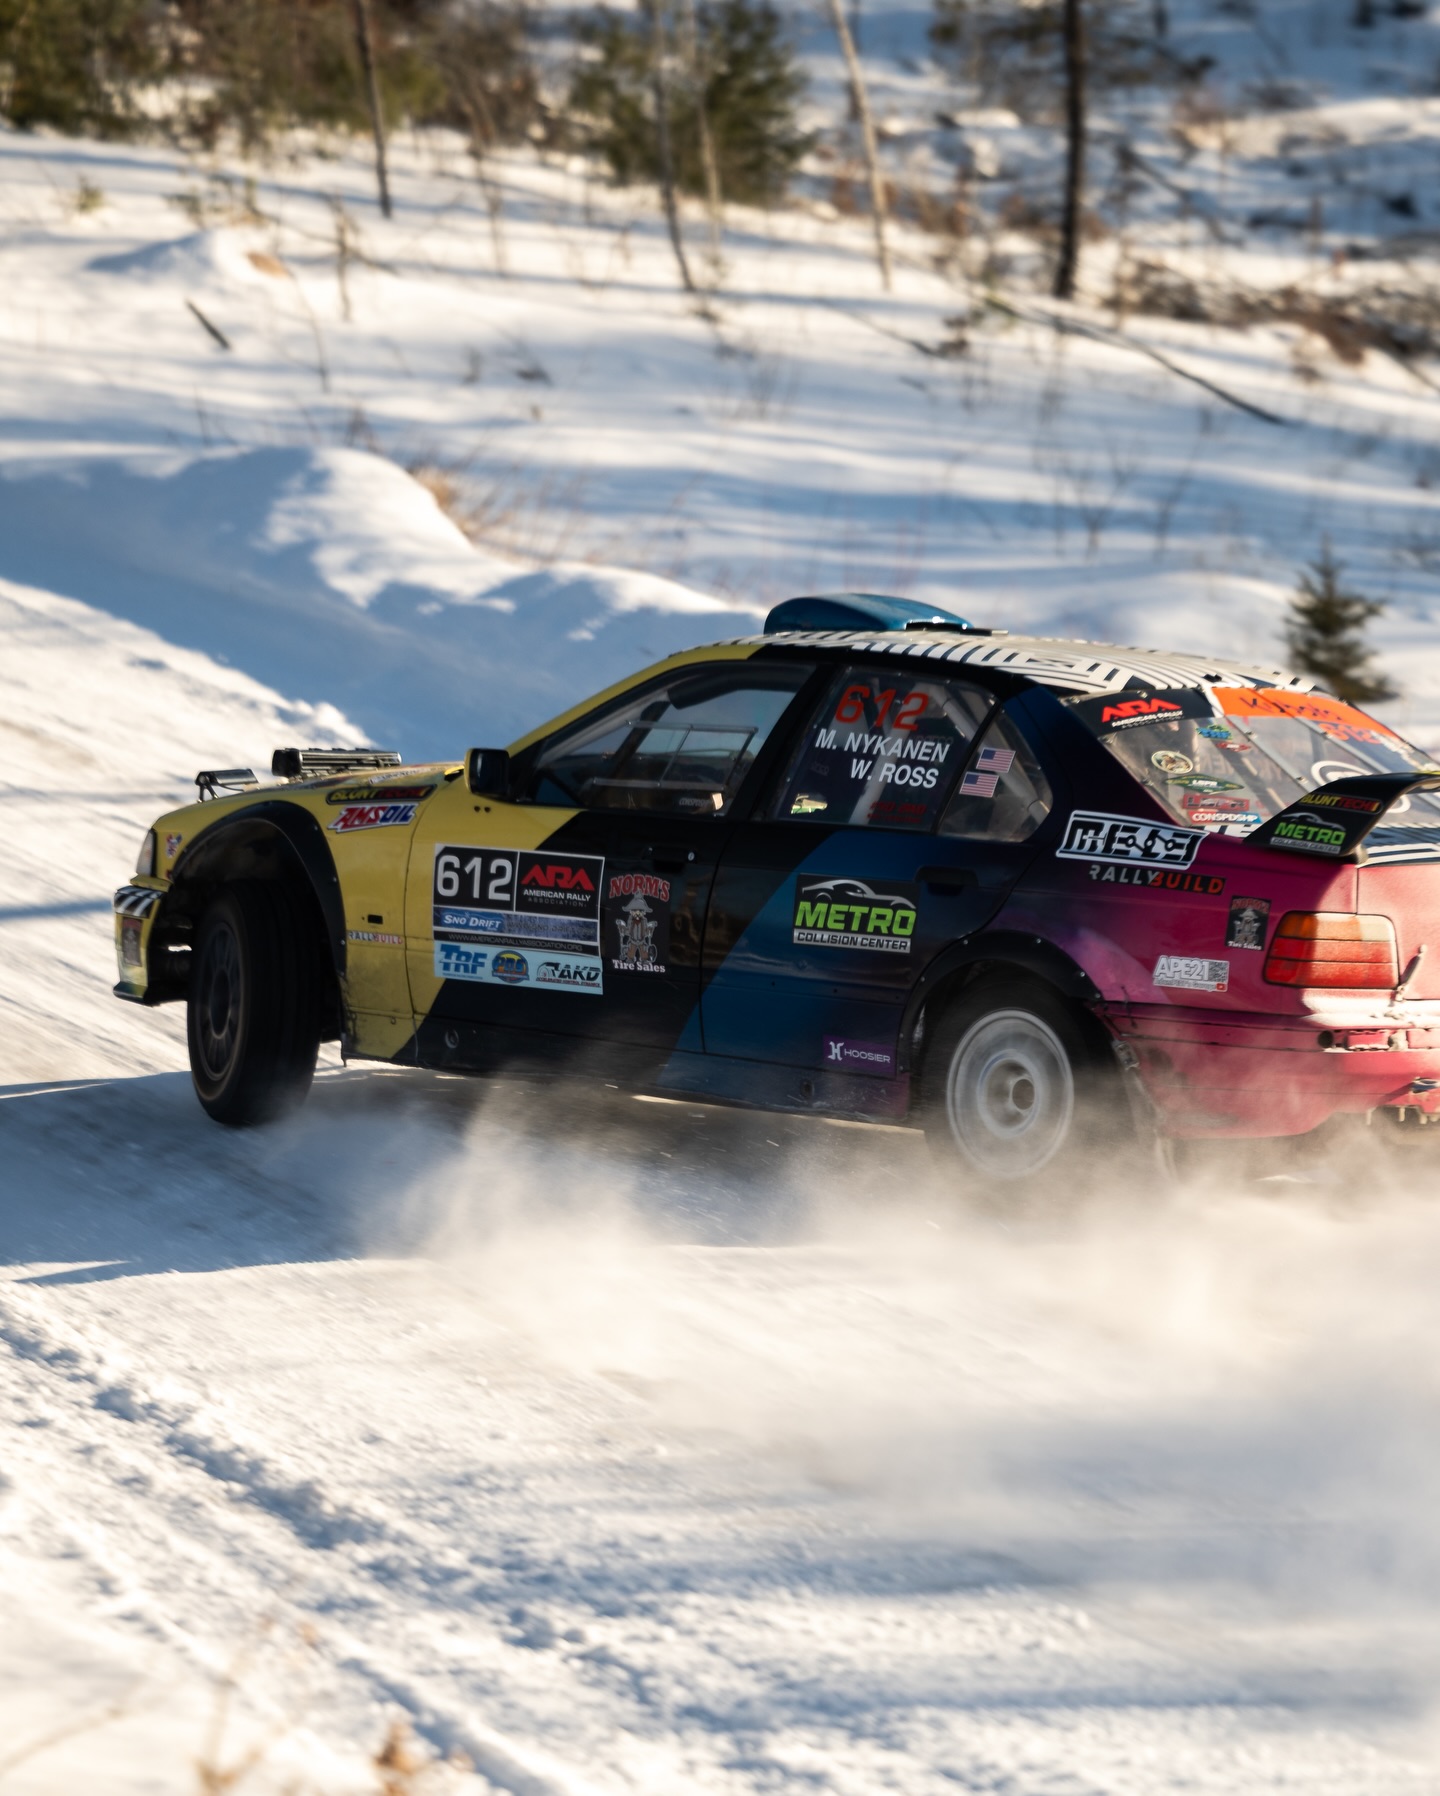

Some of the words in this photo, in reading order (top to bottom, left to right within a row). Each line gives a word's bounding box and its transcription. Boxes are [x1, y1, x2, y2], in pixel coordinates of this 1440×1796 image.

[834, 684, 929, 731] 612
[1102, 698, 1182, 723] ARA
[1112, 714, 1157, 727] AMERICAN
[1157, 710, 1184, 719] RALLY
[815, 728, 836, 750] M.
[844, 732, 950, 763] NYKANEN
[851, 758, 872, 781] W.
[879, 763, 939, 789] ROSS
[333, 805, 414, 829] AMSOIL
[1274, 822, 1346, 846] METRO
[437, 855, 512, 901] 612
[521, 864, 595, 891] ARA
[609, 874, 670, 902] NORM'S
[523, 889, 564, 900] AMERICAN
[566, 893, 591, 902] RALLY
[528, 897, 585, 907] ASSOCIATION
[444, 915, 467, 926] SNO
[469, 917, 501, 929] DRIFT
[795, 901, 917, 936] METRO
[450, 934, 583, 951] WWW.AMERICANRALLYASSOCIATION.ORG
[797, 932, 858, 947] COLLISION
[860, 938, 908, 951] CENTER
[440, 943, 488, 975] TRF
[612, 959, 635, 971] Tire
[636, 961, 666, 973] Sales
[1155, 957, 1209, 981] APE21
[844, 1048, 890, 1063] HOOSIER
